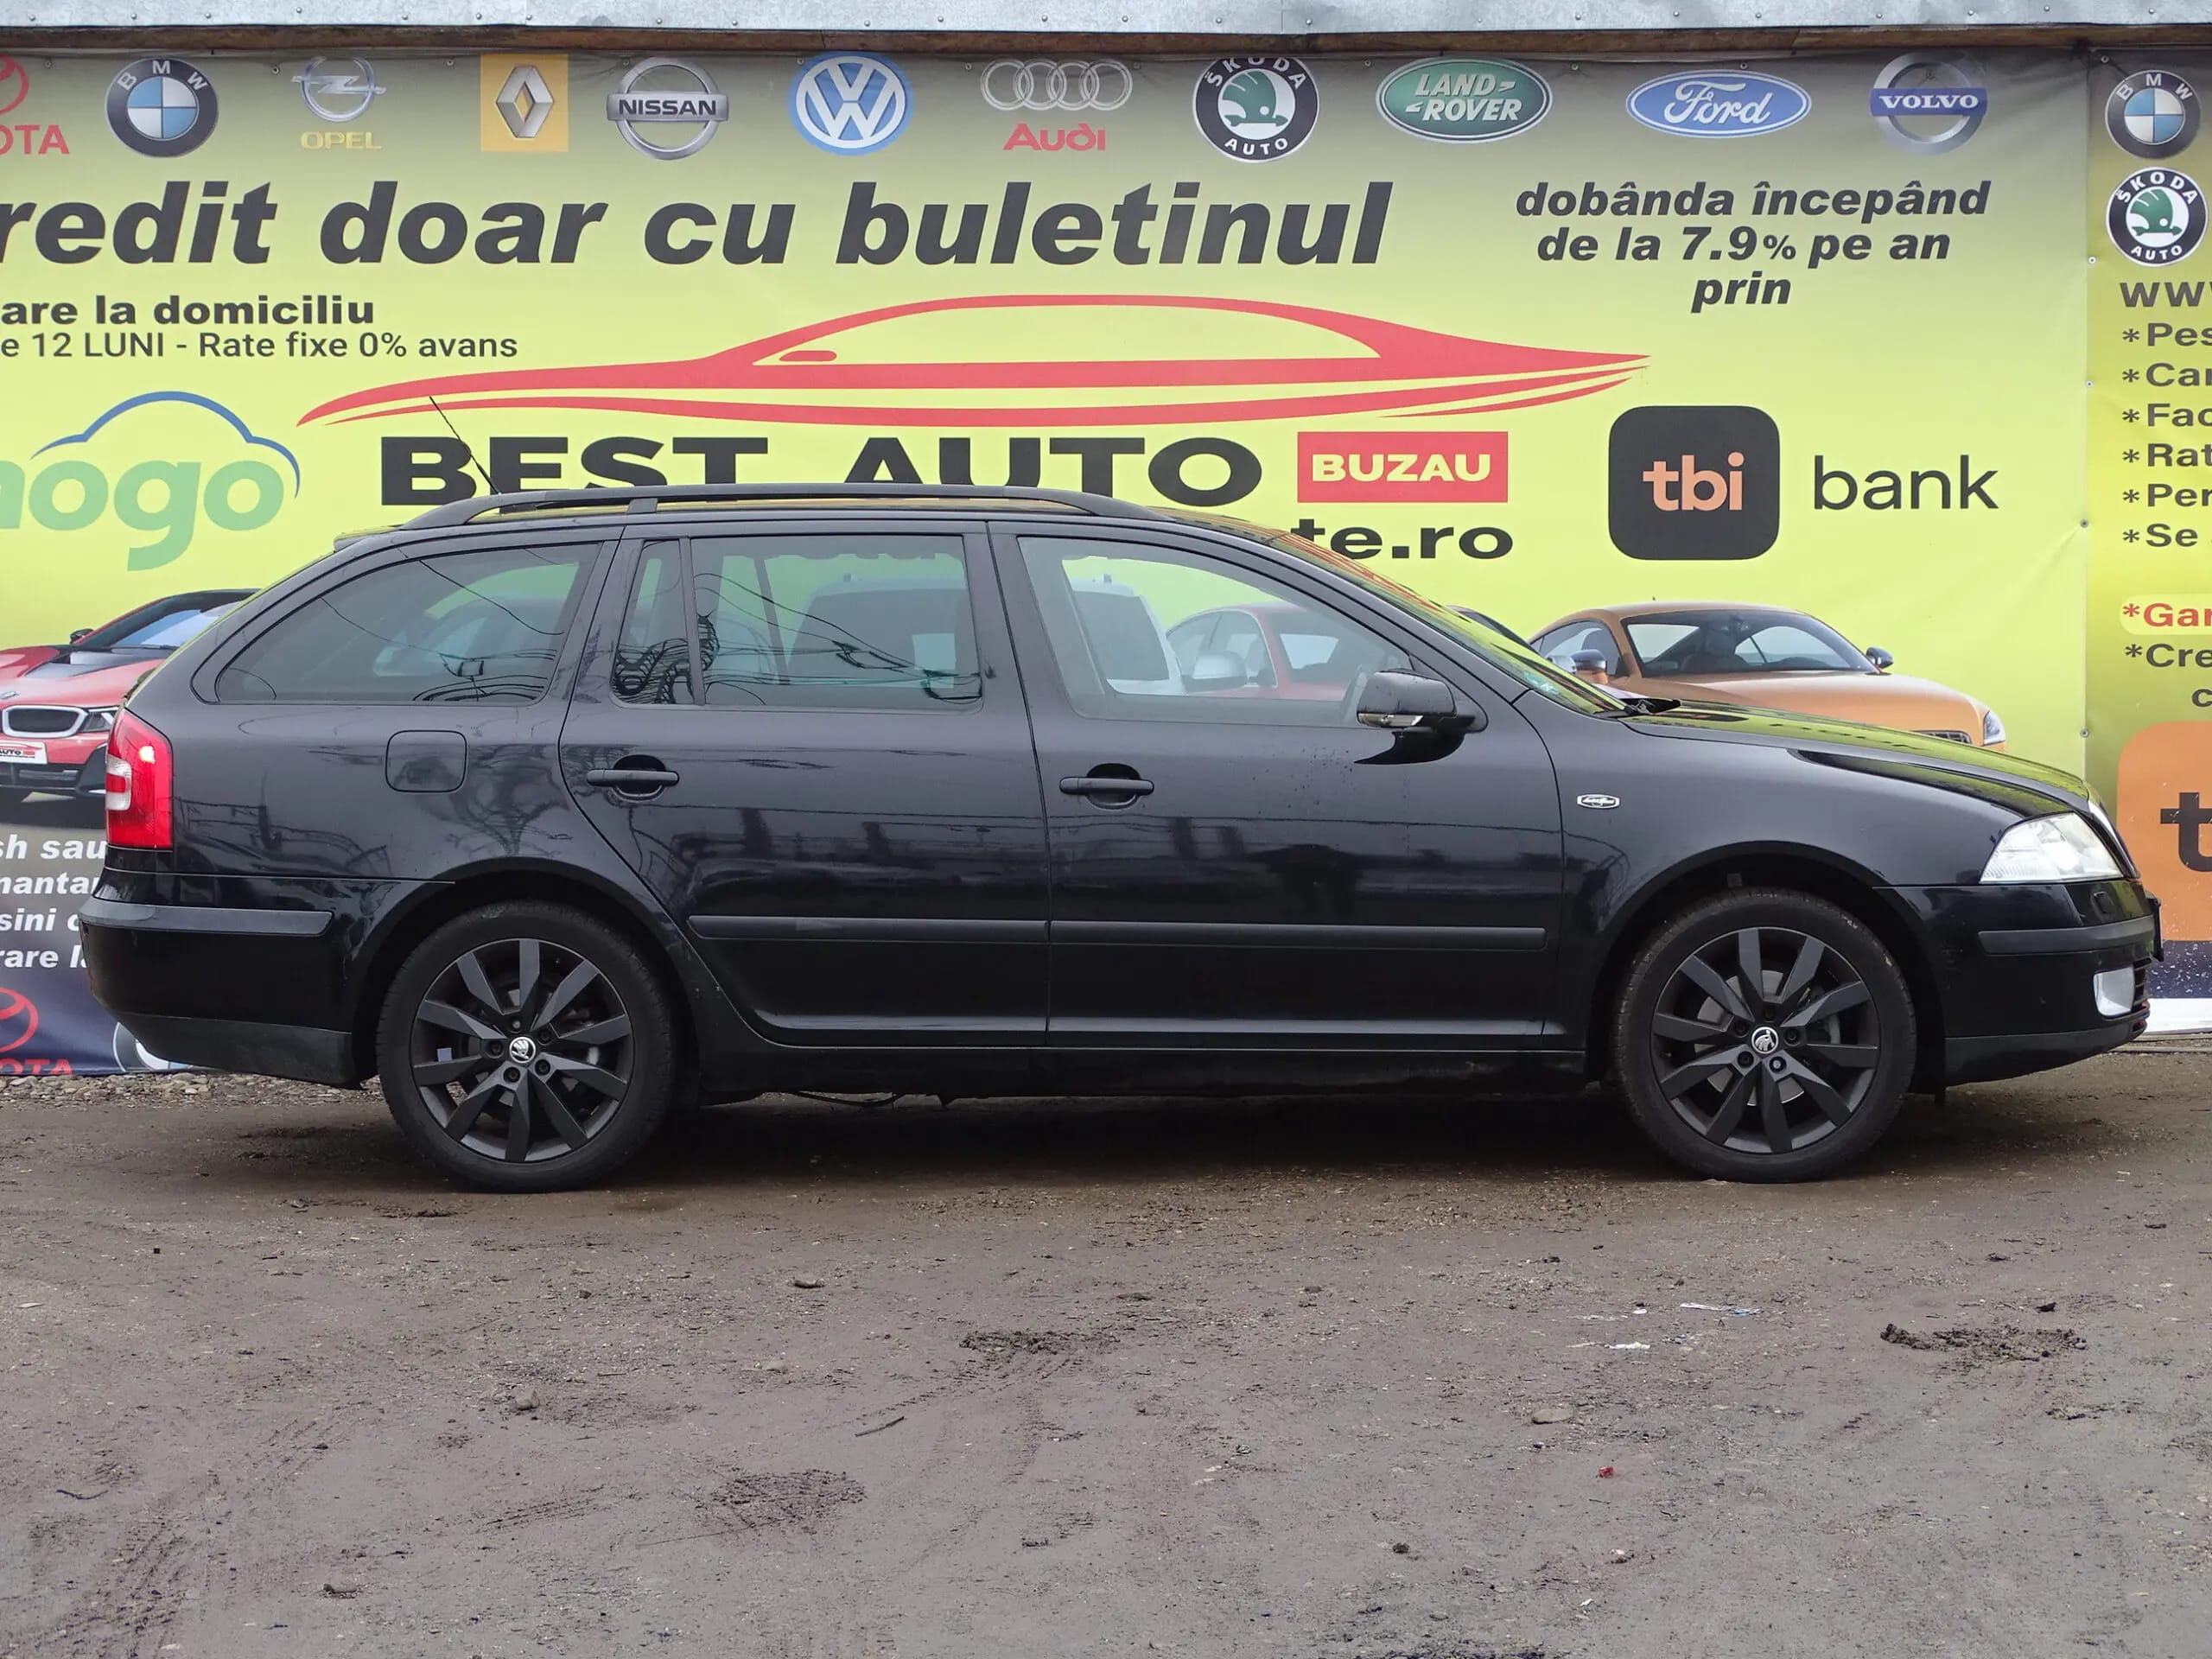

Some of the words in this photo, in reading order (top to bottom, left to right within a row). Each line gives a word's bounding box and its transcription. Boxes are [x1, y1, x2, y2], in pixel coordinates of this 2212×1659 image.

[118, 60, 208, 90] BMW
[1414, 74, 1499, 96] LAND
[2116, 73, 2193, 101] BMW
[619, 99, 717, 116] NISSAN
[1422, 99, 1524, 121] ROVER
[1663, 79, 1771, 124] Ford
[1878, 93, 1979, 110] VOLVO
[300, 130, 382, 150] OPEL
[1002, 123, 1106, 151] Audi
[1224, 137, 1288, 156] AUTO
[1516, 181, 1734, 216] dobânda
[1751, 180, 1992, 224] începând
[0, 181, 277, 264] redit
[321, 181, 608, 264] doar
[645, 201, 796, 265] cu
[836, 181, 1394, 265] buletinul
[1537, 227, 1599, 261] de
[1616, 227, 1661, 260] la
[1808, 232, 1872, 269] pe
[1889, 232, 1951, 260] an
[2131, 245, 2183, 261] AUTO
[1691, 270, 1792, 314] prin
[1, 302, 78, 325] are
[96, 295, 136, 325] la
[154, 295, 374, 325] domiciliu
[1, 338, 19, 357] e
[32, 332, 73, 357] 12
[85, 332, 164, 357] LUNI
[199, 332, 276, 357] Rate
[286, 329, 347, 357] fixe
[359, 332, 408, 357] 0%
[418, 337, 518, 357] avans
[381, 436, 768, 506] BEST
[844, 437, 1262, 507] AUTO
[1312, 453, 1491, 482] BUZAU
[1643, 451, 1745, 512] tbi
[1814, 454, 1999, 511] bank
[40, 839, 107, 860] sau
